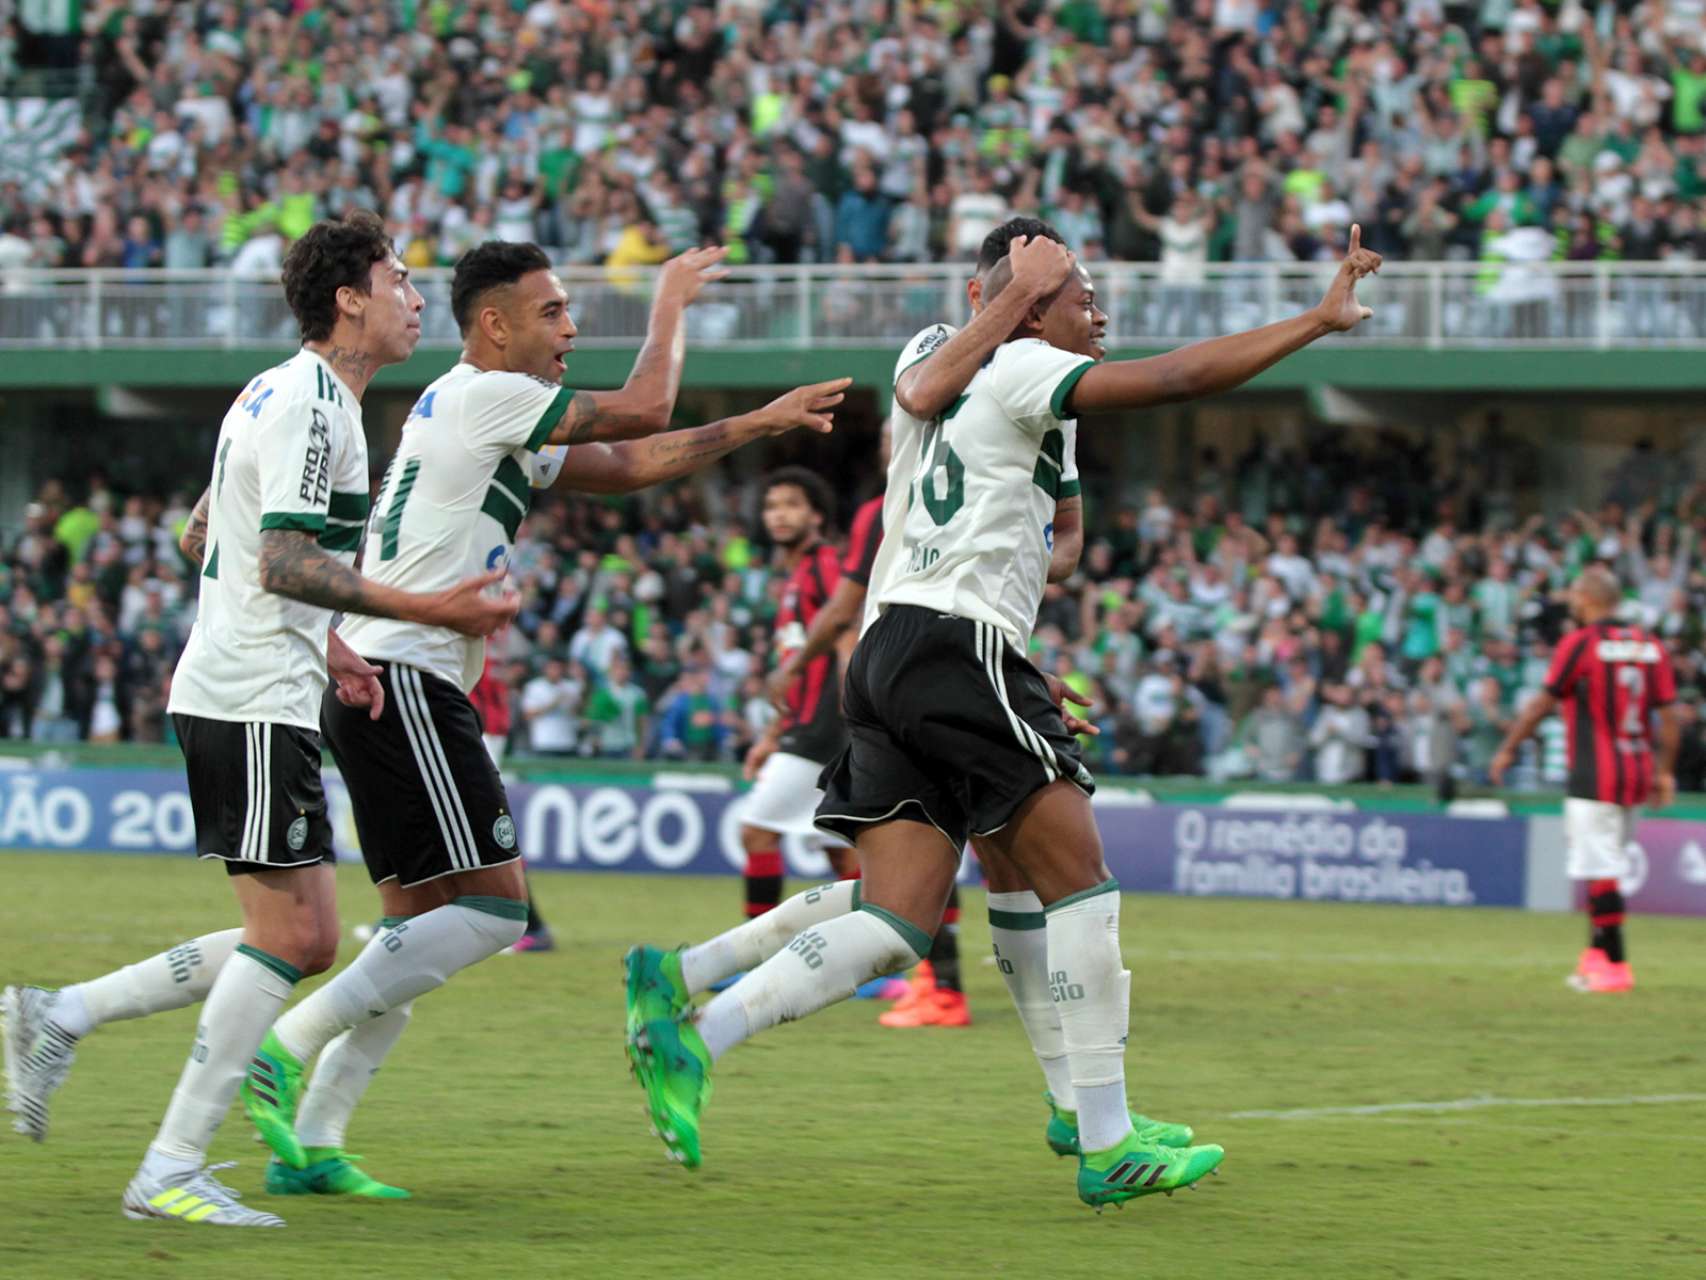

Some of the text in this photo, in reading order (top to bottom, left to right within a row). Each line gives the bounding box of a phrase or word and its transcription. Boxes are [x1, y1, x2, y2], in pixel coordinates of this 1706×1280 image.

[299, 446, 320, 503] PRO
[524, 783, 705, 870] neo
[1176, 808, 1407, 863] O remédio da
[1174, 851, 1296, 897] família
